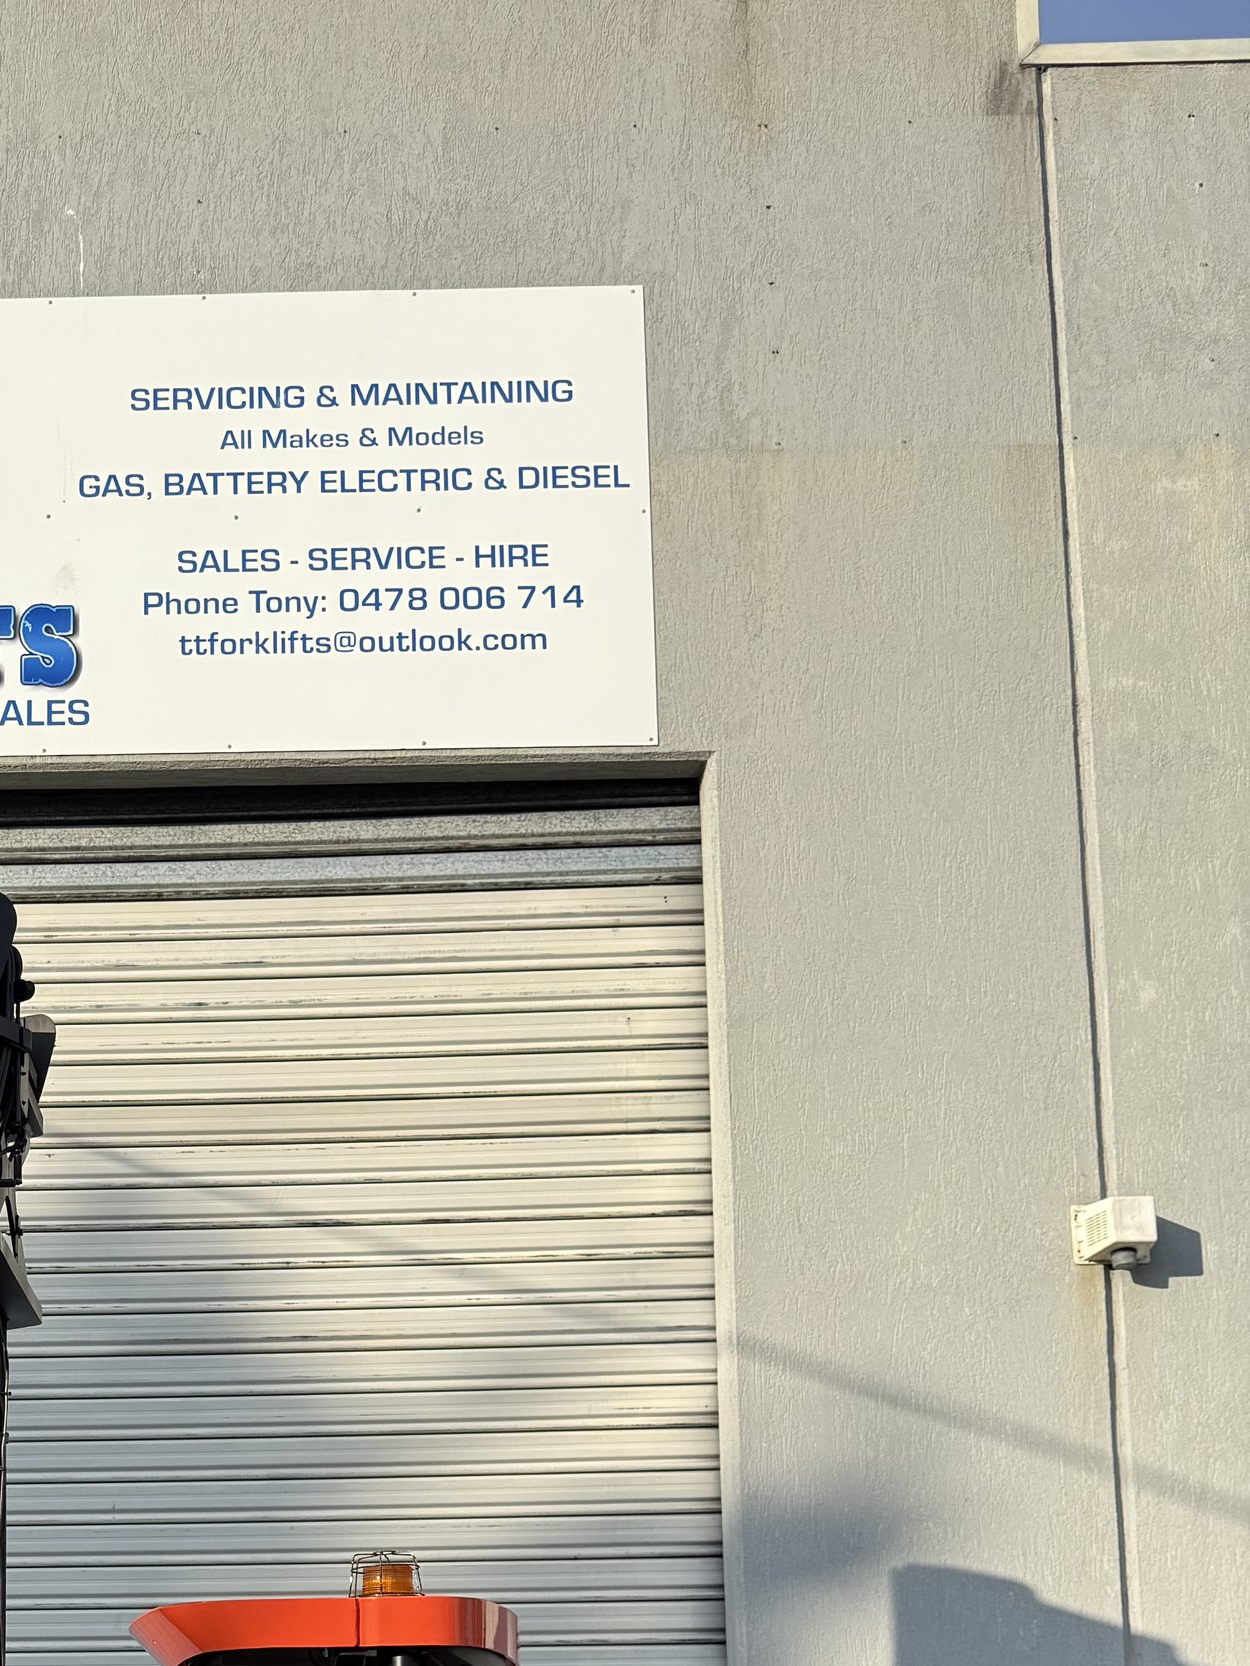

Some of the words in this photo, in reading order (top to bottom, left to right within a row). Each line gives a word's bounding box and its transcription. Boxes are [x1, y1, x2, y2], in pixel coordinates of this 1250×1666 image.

[131, 386, 304, 411] SERVICING
[317, 386, 339, 407] &
[351, 380, 573, 406] MAINTAINING
[220, 430, 251, 449] All
[263, 429, 349, 448] Makes
[359, 428, 378, 447] &
[388, 425, 483, 446] Models
[79, 474, 151, 500] GAS,
[165, 471, 309, 496] BATTERY
[321, 468, 472, 493] ELECTRIC
[484, 468, 507, 490] &
[519, 465, 630, 489] DIESEL
[178, 549, 280, 573] SALES
[309, 546, 445, 571] SERVICE
[475, 544, 549, 568] HIRE
[144, 592, 238, 615] Phone
[249, 590, 326, 619] Tony:
[340, 588, 427, 612] 0478
[440, 586, 505, 610] 006
[518, 585, 584, 608] 714
[179, 628, 547, 655] ttforklifts@outlook.com
